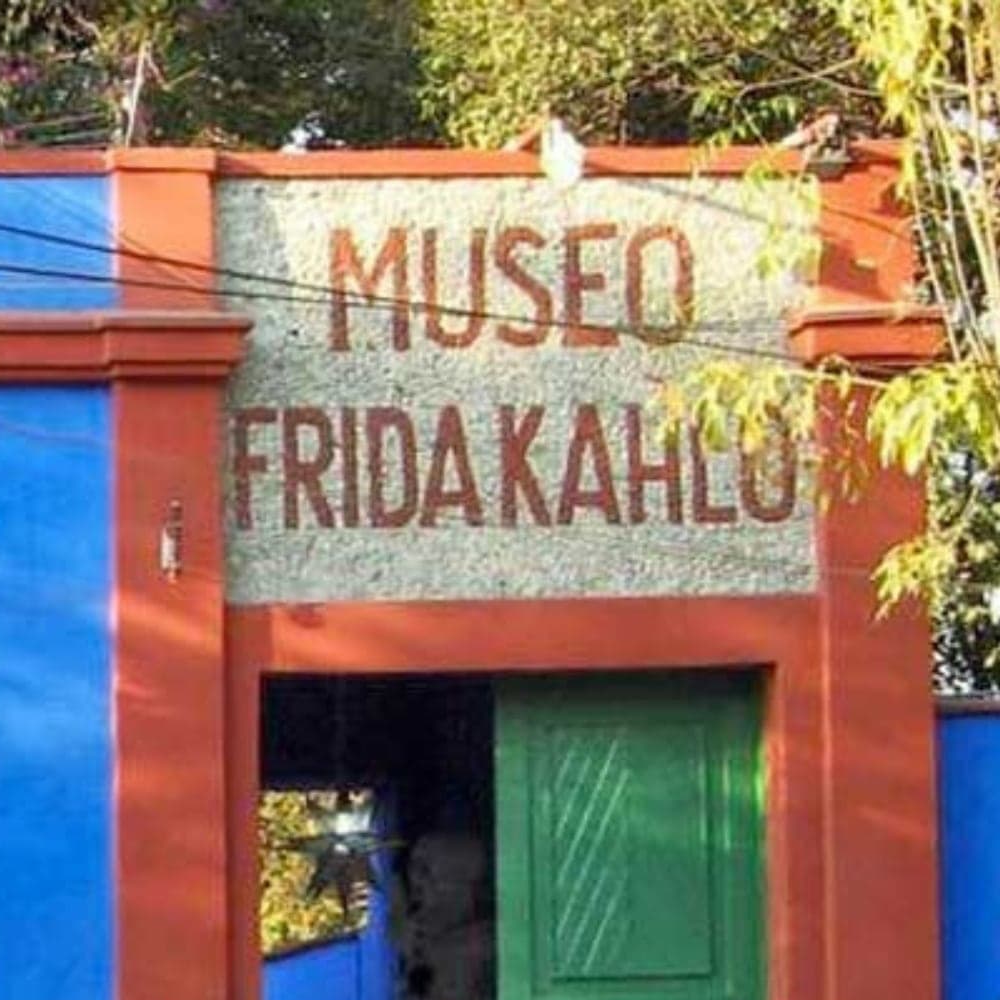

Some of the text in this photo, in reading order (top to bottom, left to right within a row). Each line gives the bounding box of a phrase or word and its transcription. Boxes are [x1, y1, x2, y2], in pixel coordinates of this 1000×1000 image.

[328, 223, 694, 352] MUSEO
[232, 402, 797, 529] FRIDA KAHLO
